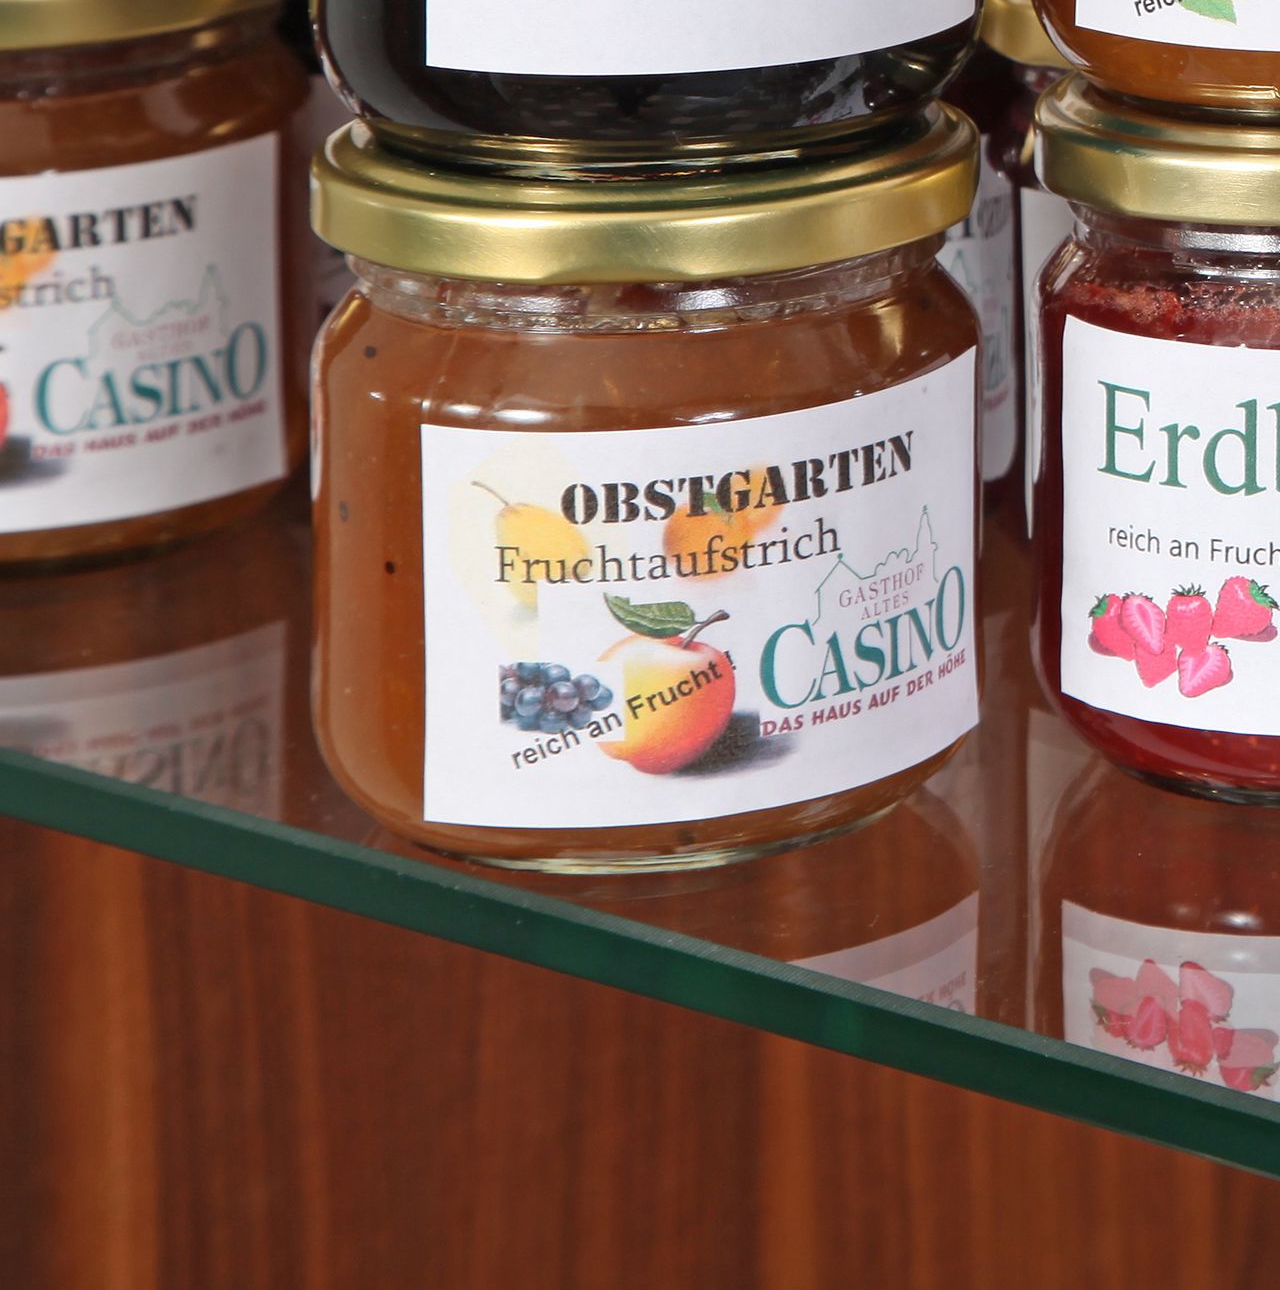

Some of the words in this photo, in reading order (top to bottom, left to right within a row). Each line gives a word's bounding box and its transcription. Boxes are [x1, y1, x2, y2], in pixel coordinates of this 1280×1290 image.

[34, 320, 268, 436] CASINO
[560, 430, 915, 526] OBSTGARTEN
[495, 518, 841, 585] Fruchtaufstrich
[838, 562, 926, 608] GASTHOF
[1108, 524, 1161, 555] reich
[1169, 539, 1200, 560] an
[760, 565, 966, 709] CASINO
[861, 591, 910, 620] ALTES
[511, 729, 581, 770] reich
[588, 711, 623, 741] an
[626, 657, 723, 721] Frucht
[760, 714, 804, 738] DAS
[811, 701, 862, 728] HAUS
[868, 687, 901, 712] AUF
[906, 673, 934, 698] DER
[938, 648, 966, 687] HÖHE
